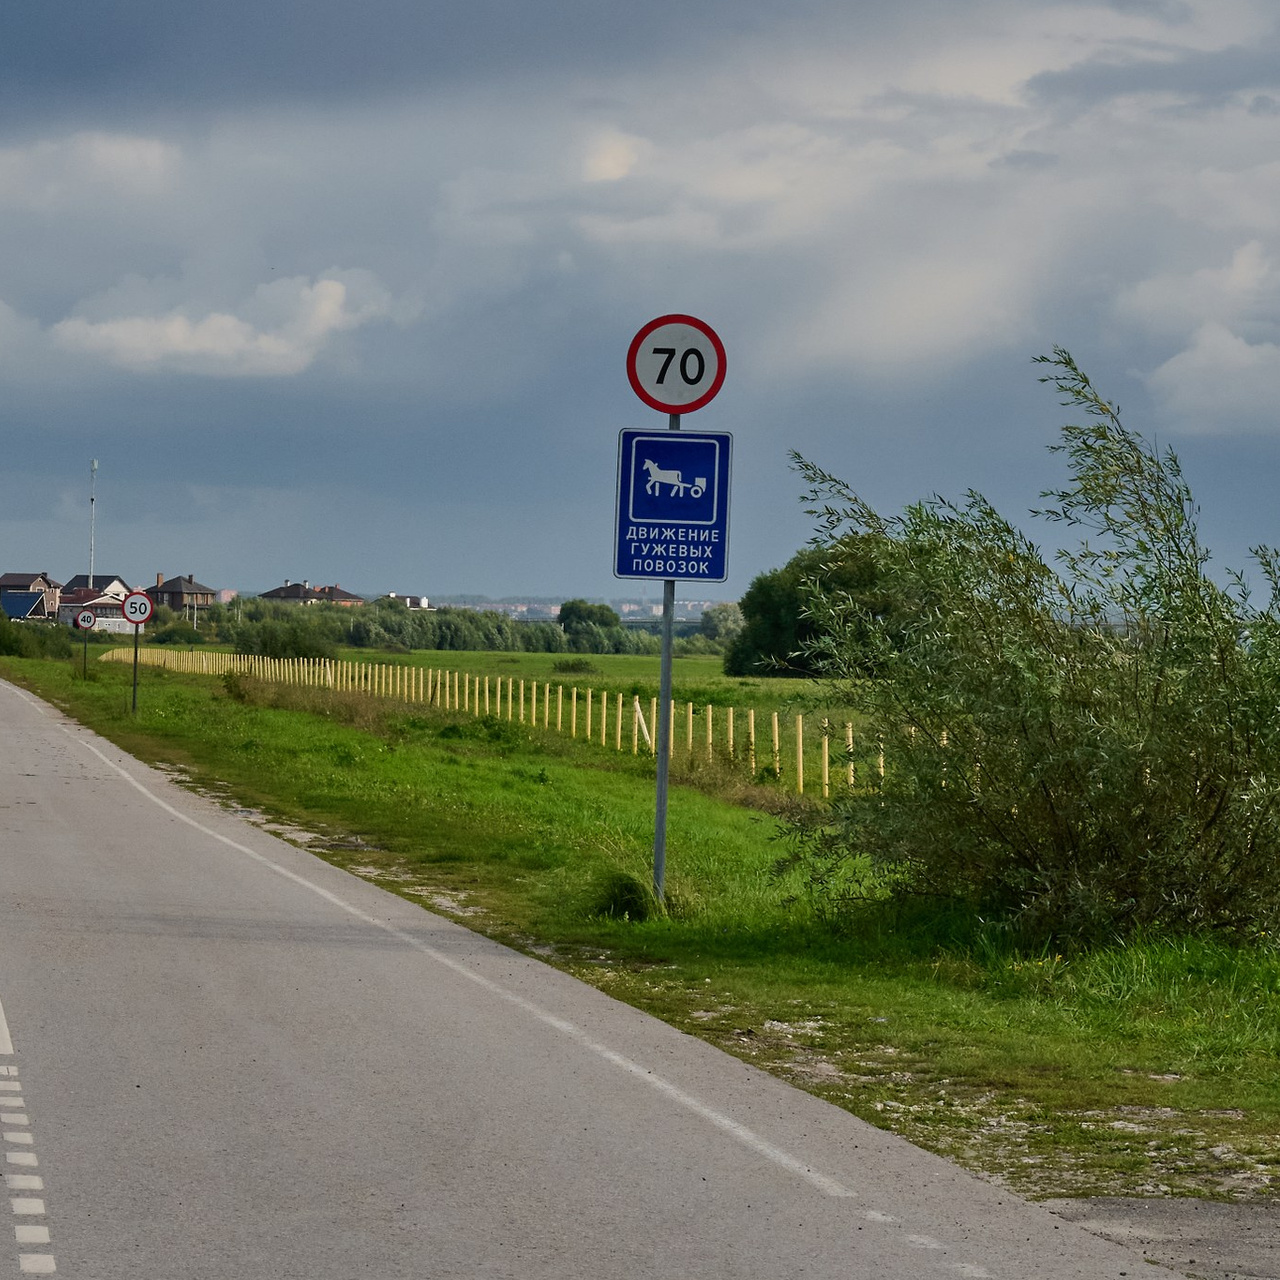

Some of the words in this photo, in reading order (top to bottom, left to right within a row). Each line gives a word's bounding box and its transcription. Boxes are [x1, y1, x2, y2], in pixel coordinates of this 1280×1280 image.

[652, 347, 706, 386] 70
[626, 526, 720, 542] ДВИЖЕНИЕ
[631, 542, 713, 558] ГУЖЕВЫХ
[632, 559, 710, 574] ПОВОЗОК
[129, 602, 148, 615] 50
[80, 615, 92, 624] 40
